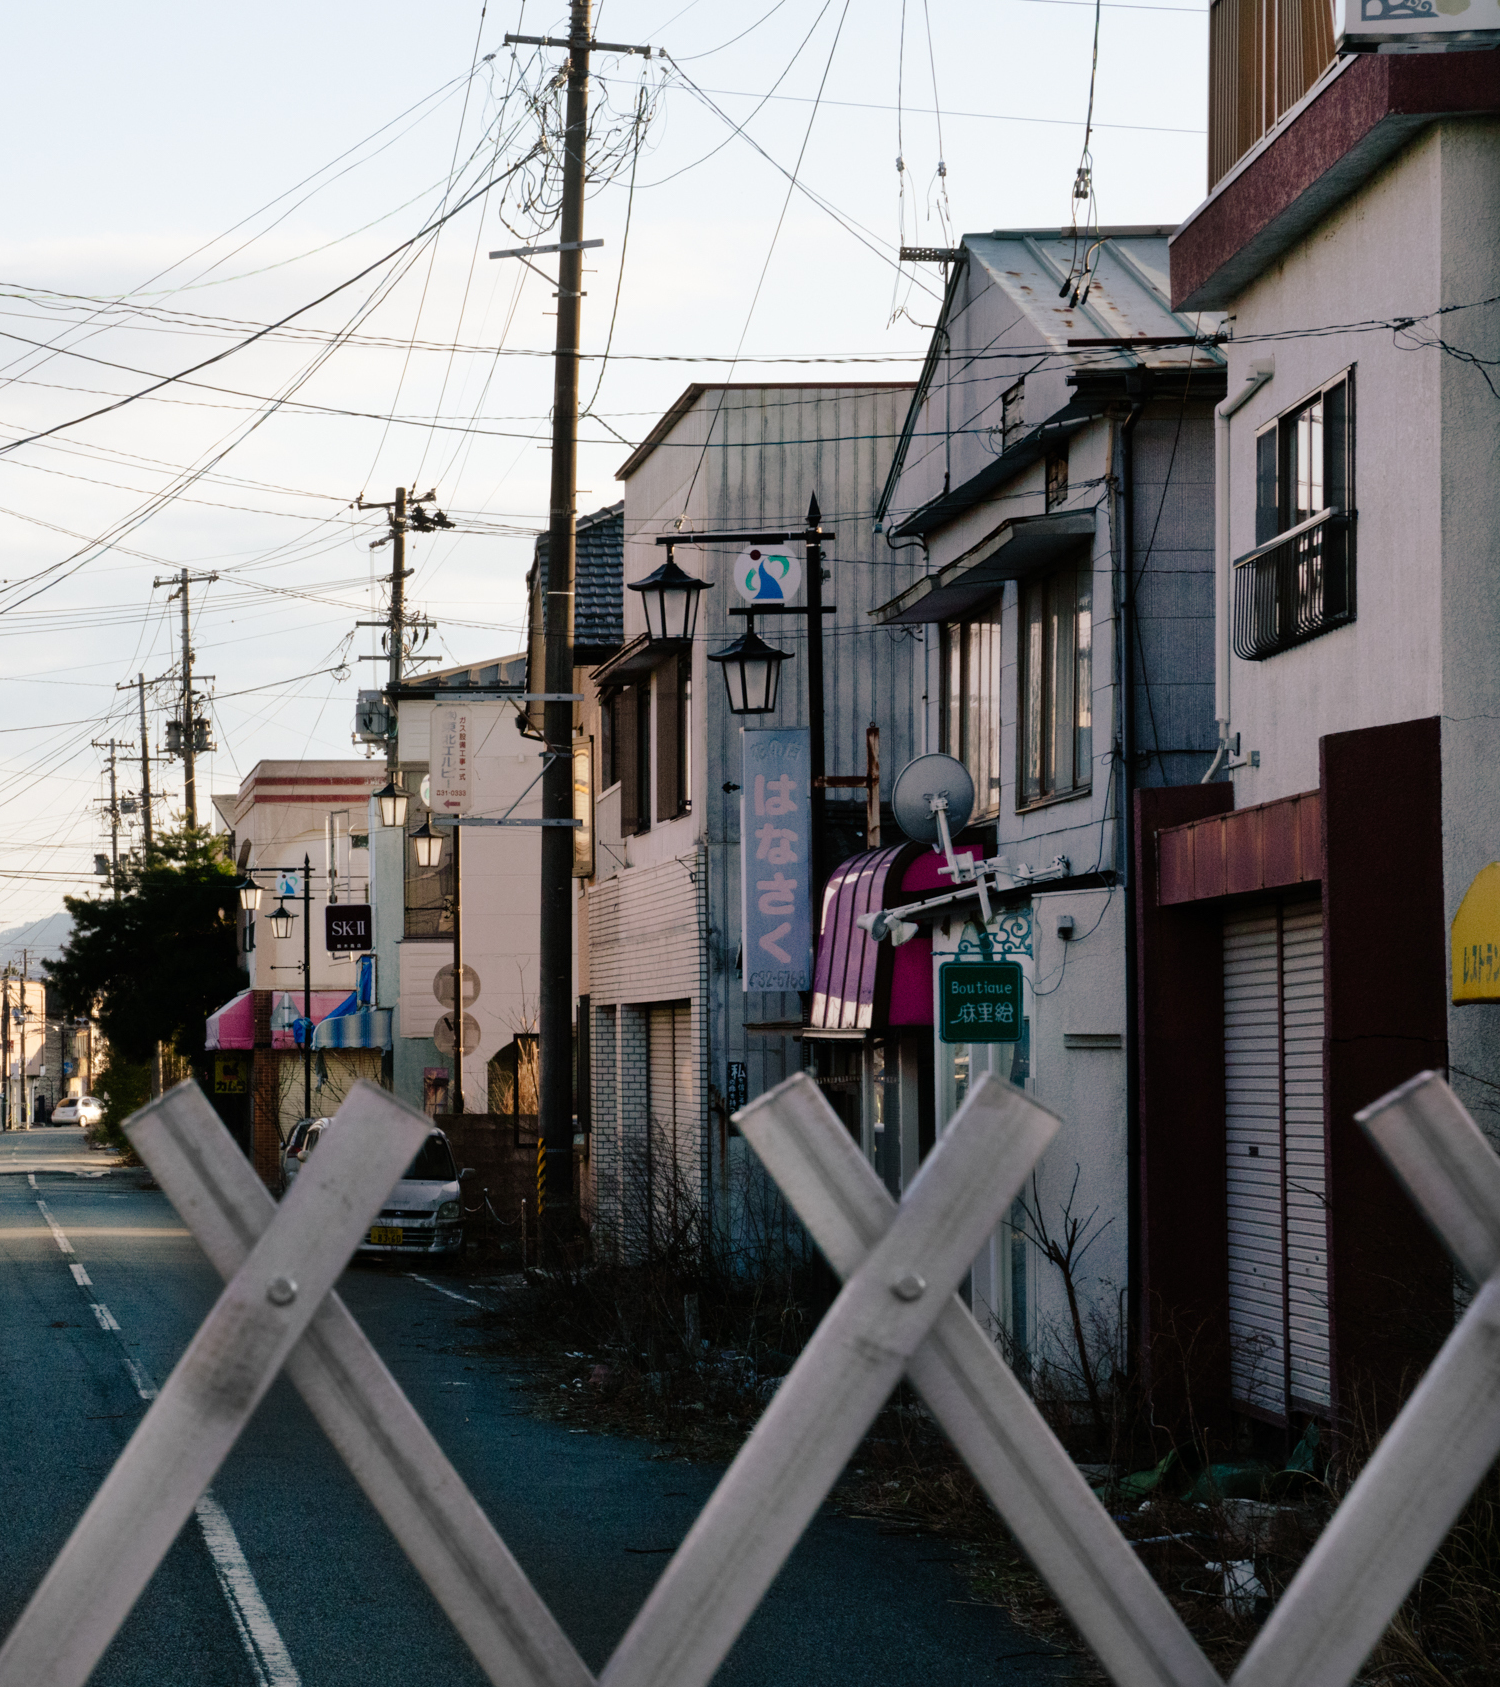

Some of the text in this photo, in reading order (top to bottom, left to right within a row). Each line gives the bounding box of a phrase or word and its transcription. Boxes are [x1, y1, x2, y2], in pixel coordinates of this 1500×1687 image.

[754, 773, 799, 964] はなさく
[331, 920, 366, 936] SK-II
